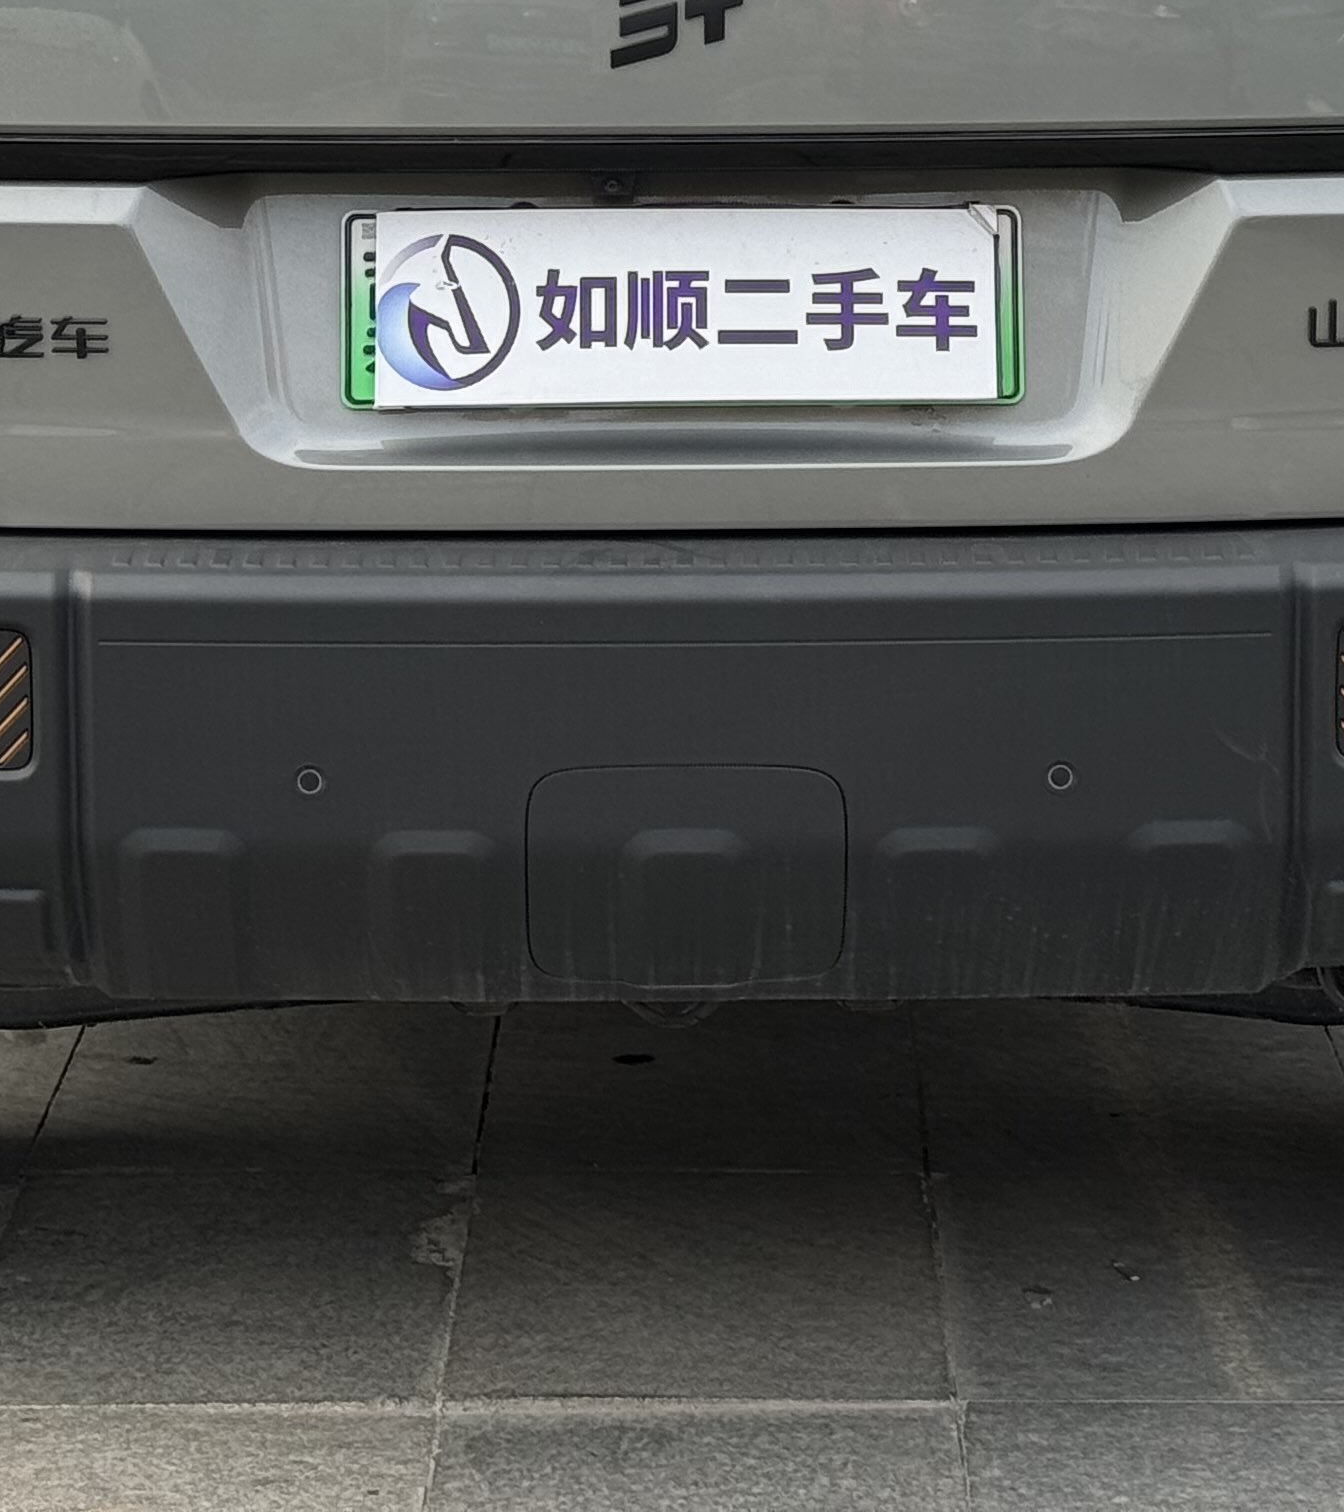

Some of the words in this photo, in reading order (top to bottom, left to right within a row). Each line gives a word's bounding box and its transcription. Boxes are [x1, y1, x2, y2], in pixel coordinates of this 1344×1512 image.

[535, 267, 978, 353] 如顺二手车
